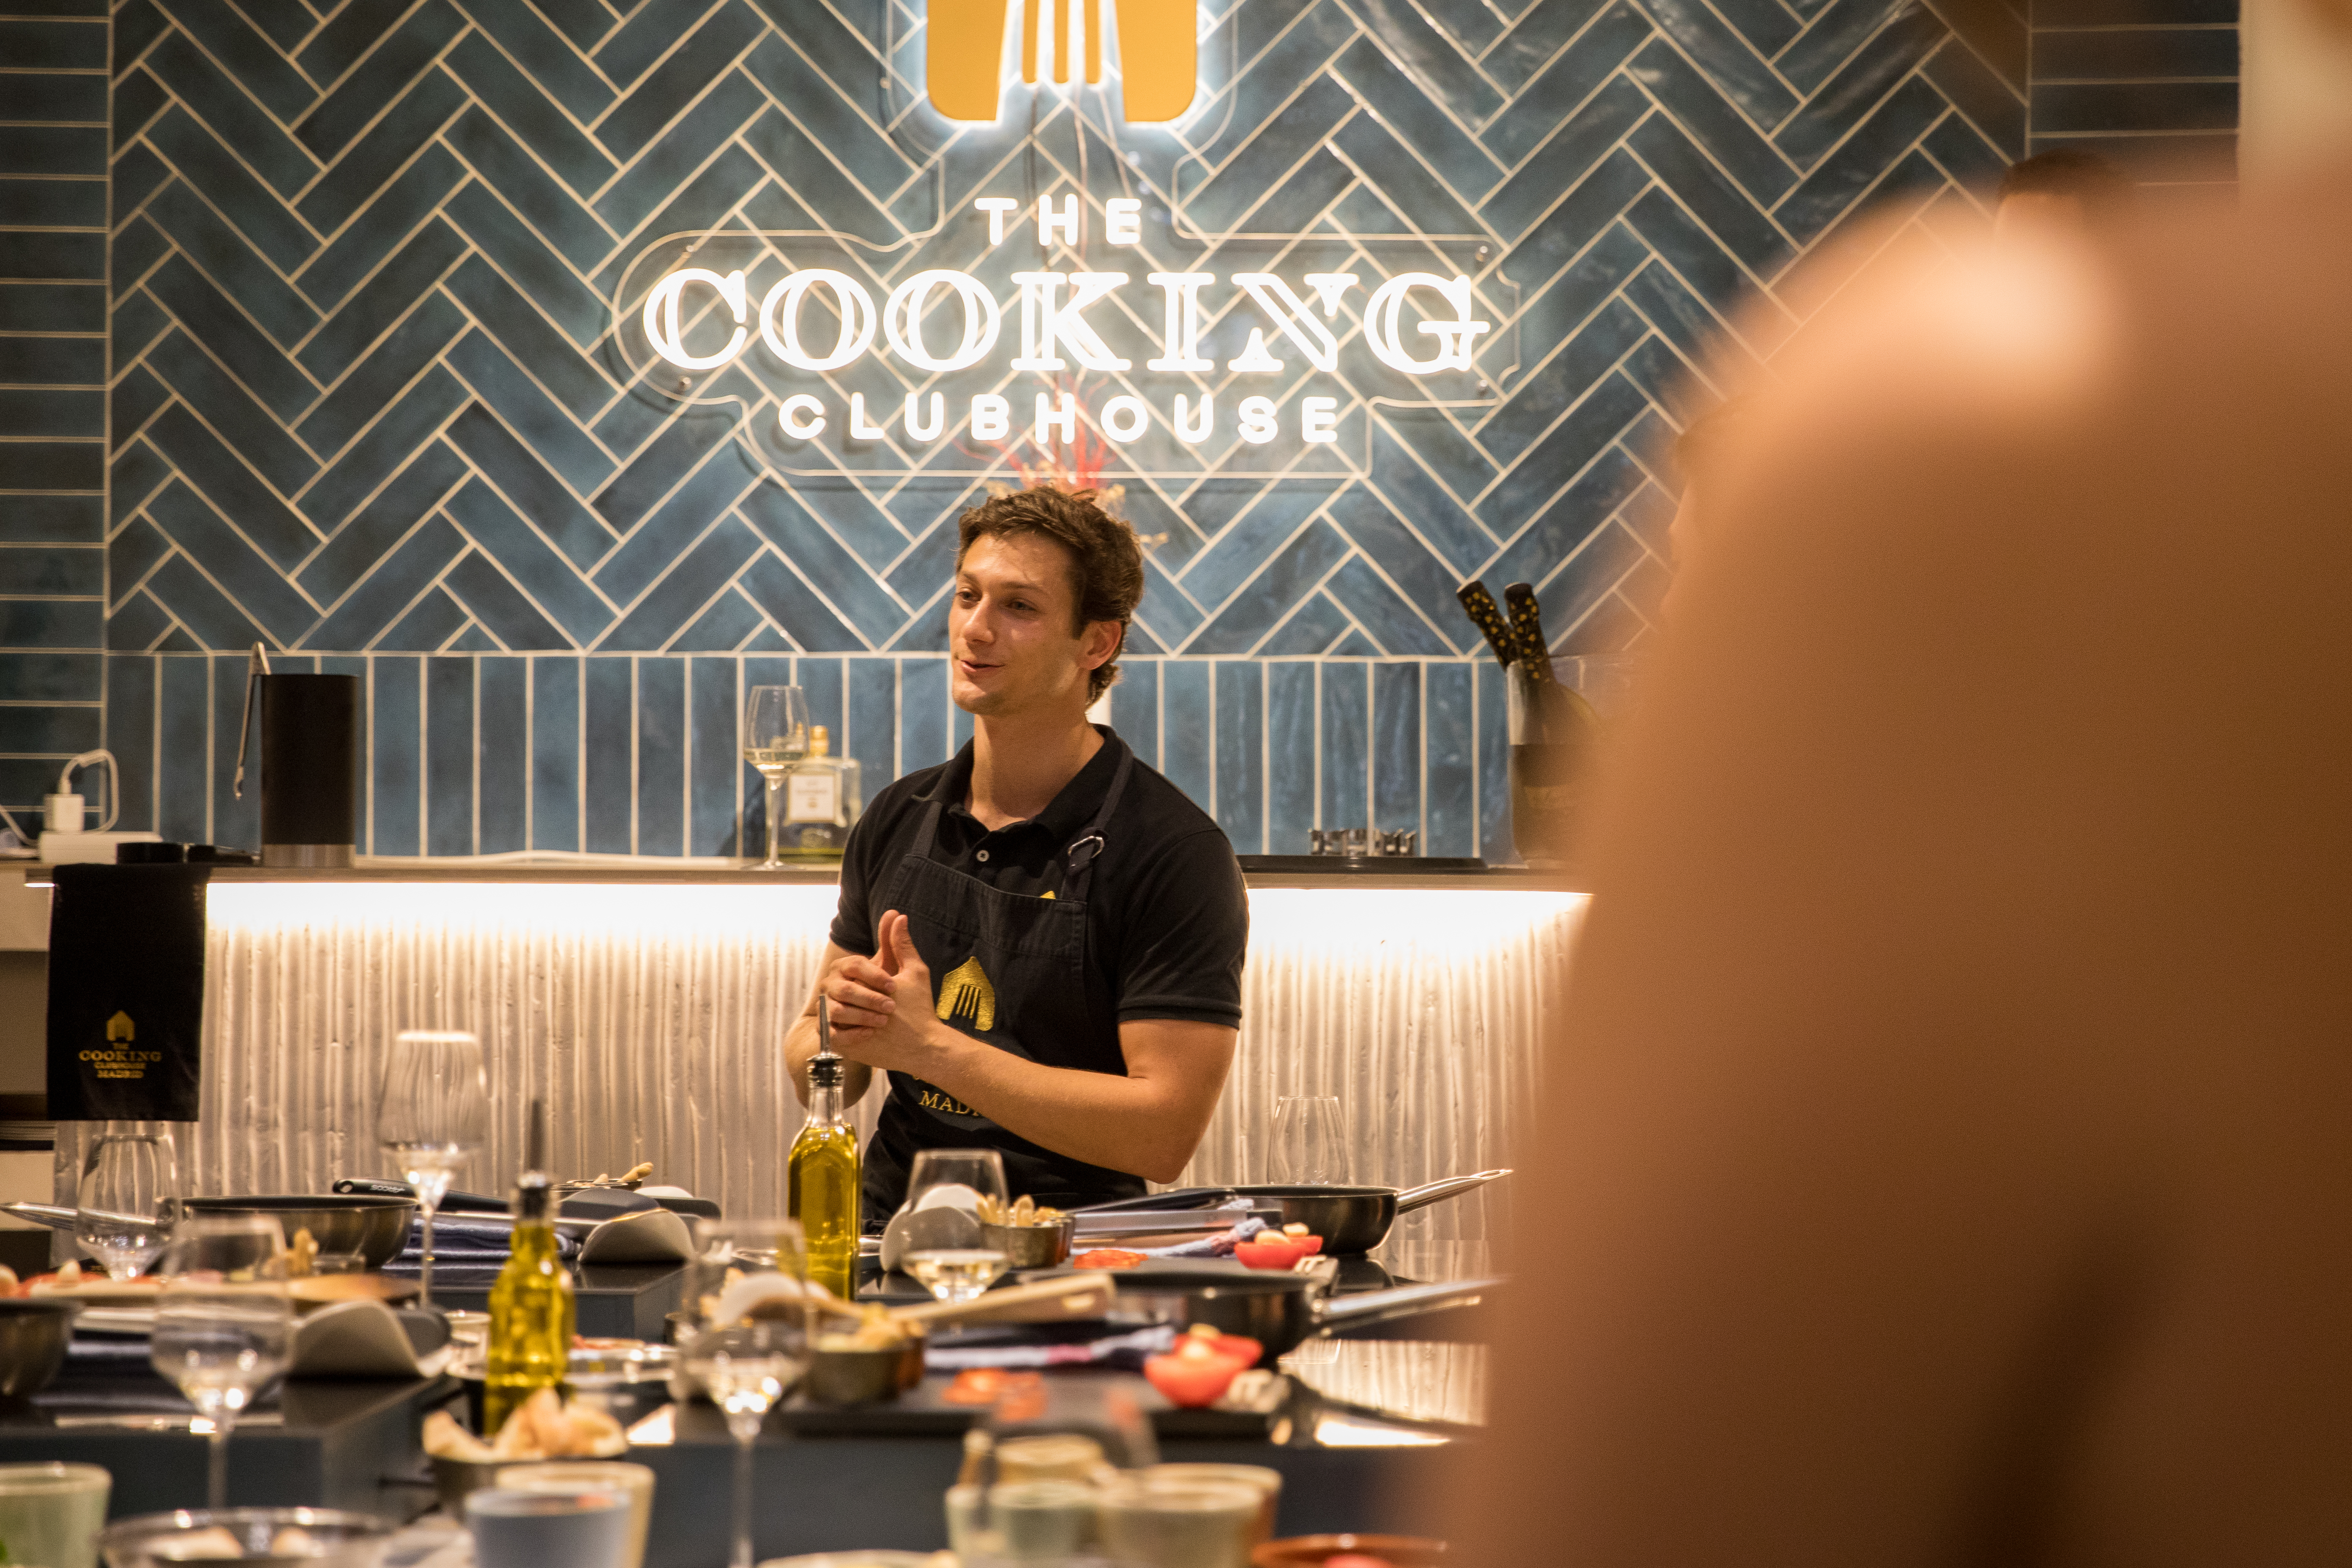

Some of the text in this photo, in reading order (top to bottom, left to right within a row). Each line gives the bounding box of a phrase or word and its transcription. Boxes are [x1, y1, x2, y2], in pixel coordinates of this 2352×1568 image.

[974, 194, 1142, 246] THE
[644, 268, 1490, 374] COOKING
[779, 392, 1338, 444] CLUBHOUSE
[79, 1050, 161, 1062] COOKING
[918, 1090, 979, 1117] MAD
